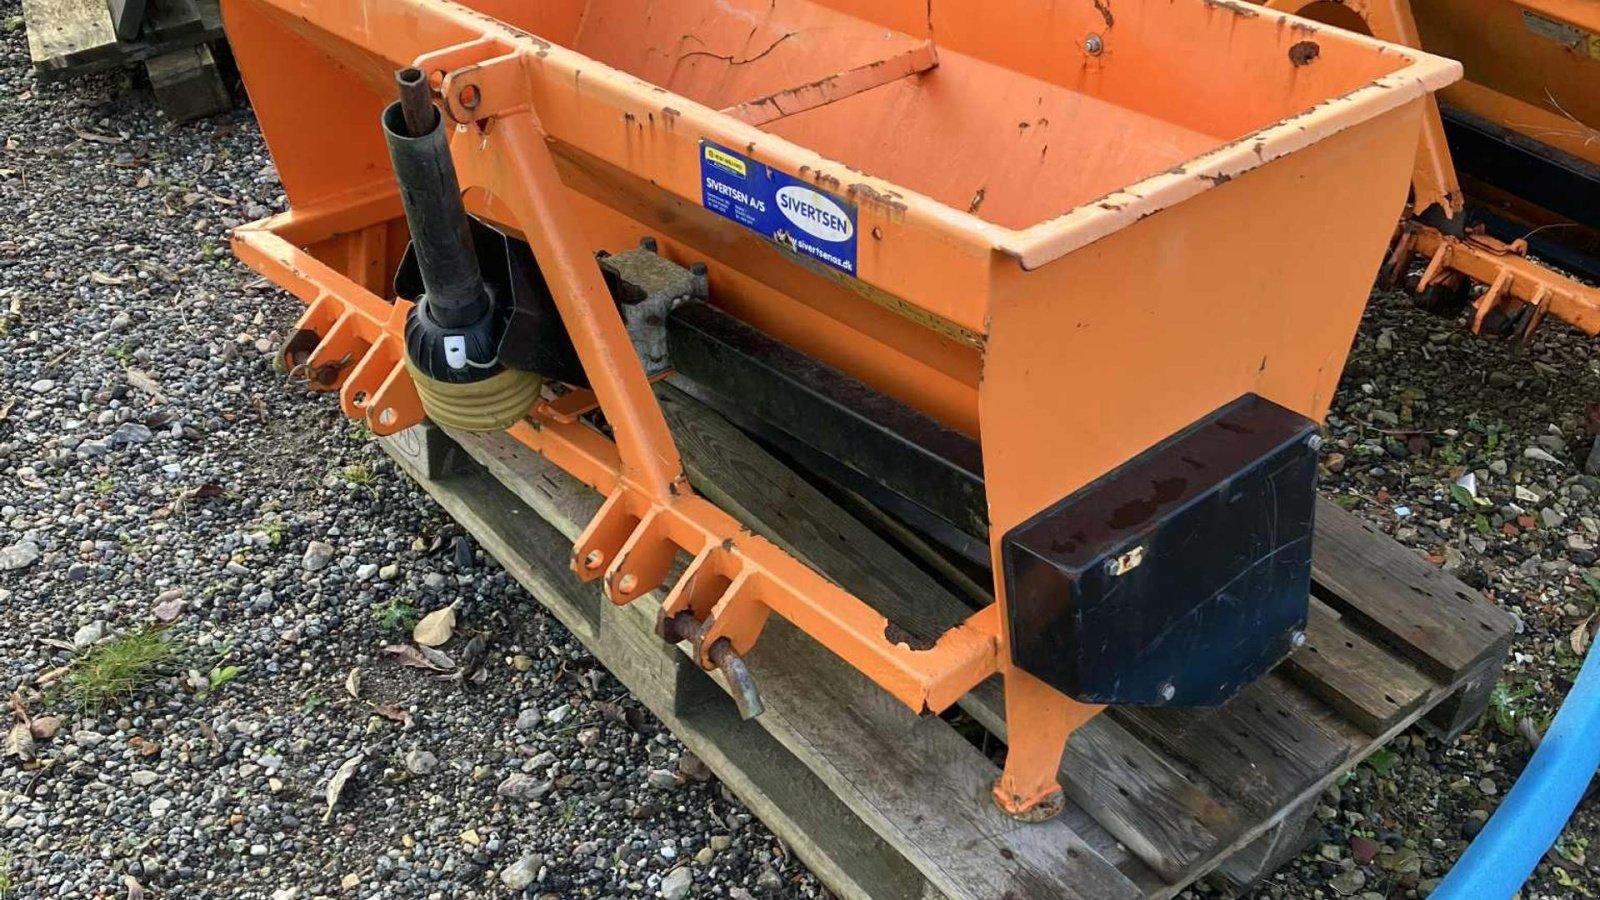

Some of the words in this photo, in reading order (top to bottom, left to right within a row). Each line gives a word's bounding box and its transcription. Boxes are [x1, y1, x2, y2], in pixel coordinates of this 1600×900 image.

[706, 177, 748, 205] SIVERTSEN
[749, 196, 766, 213] A/S
[780, 193, 847, 235] SIVERTSEN
